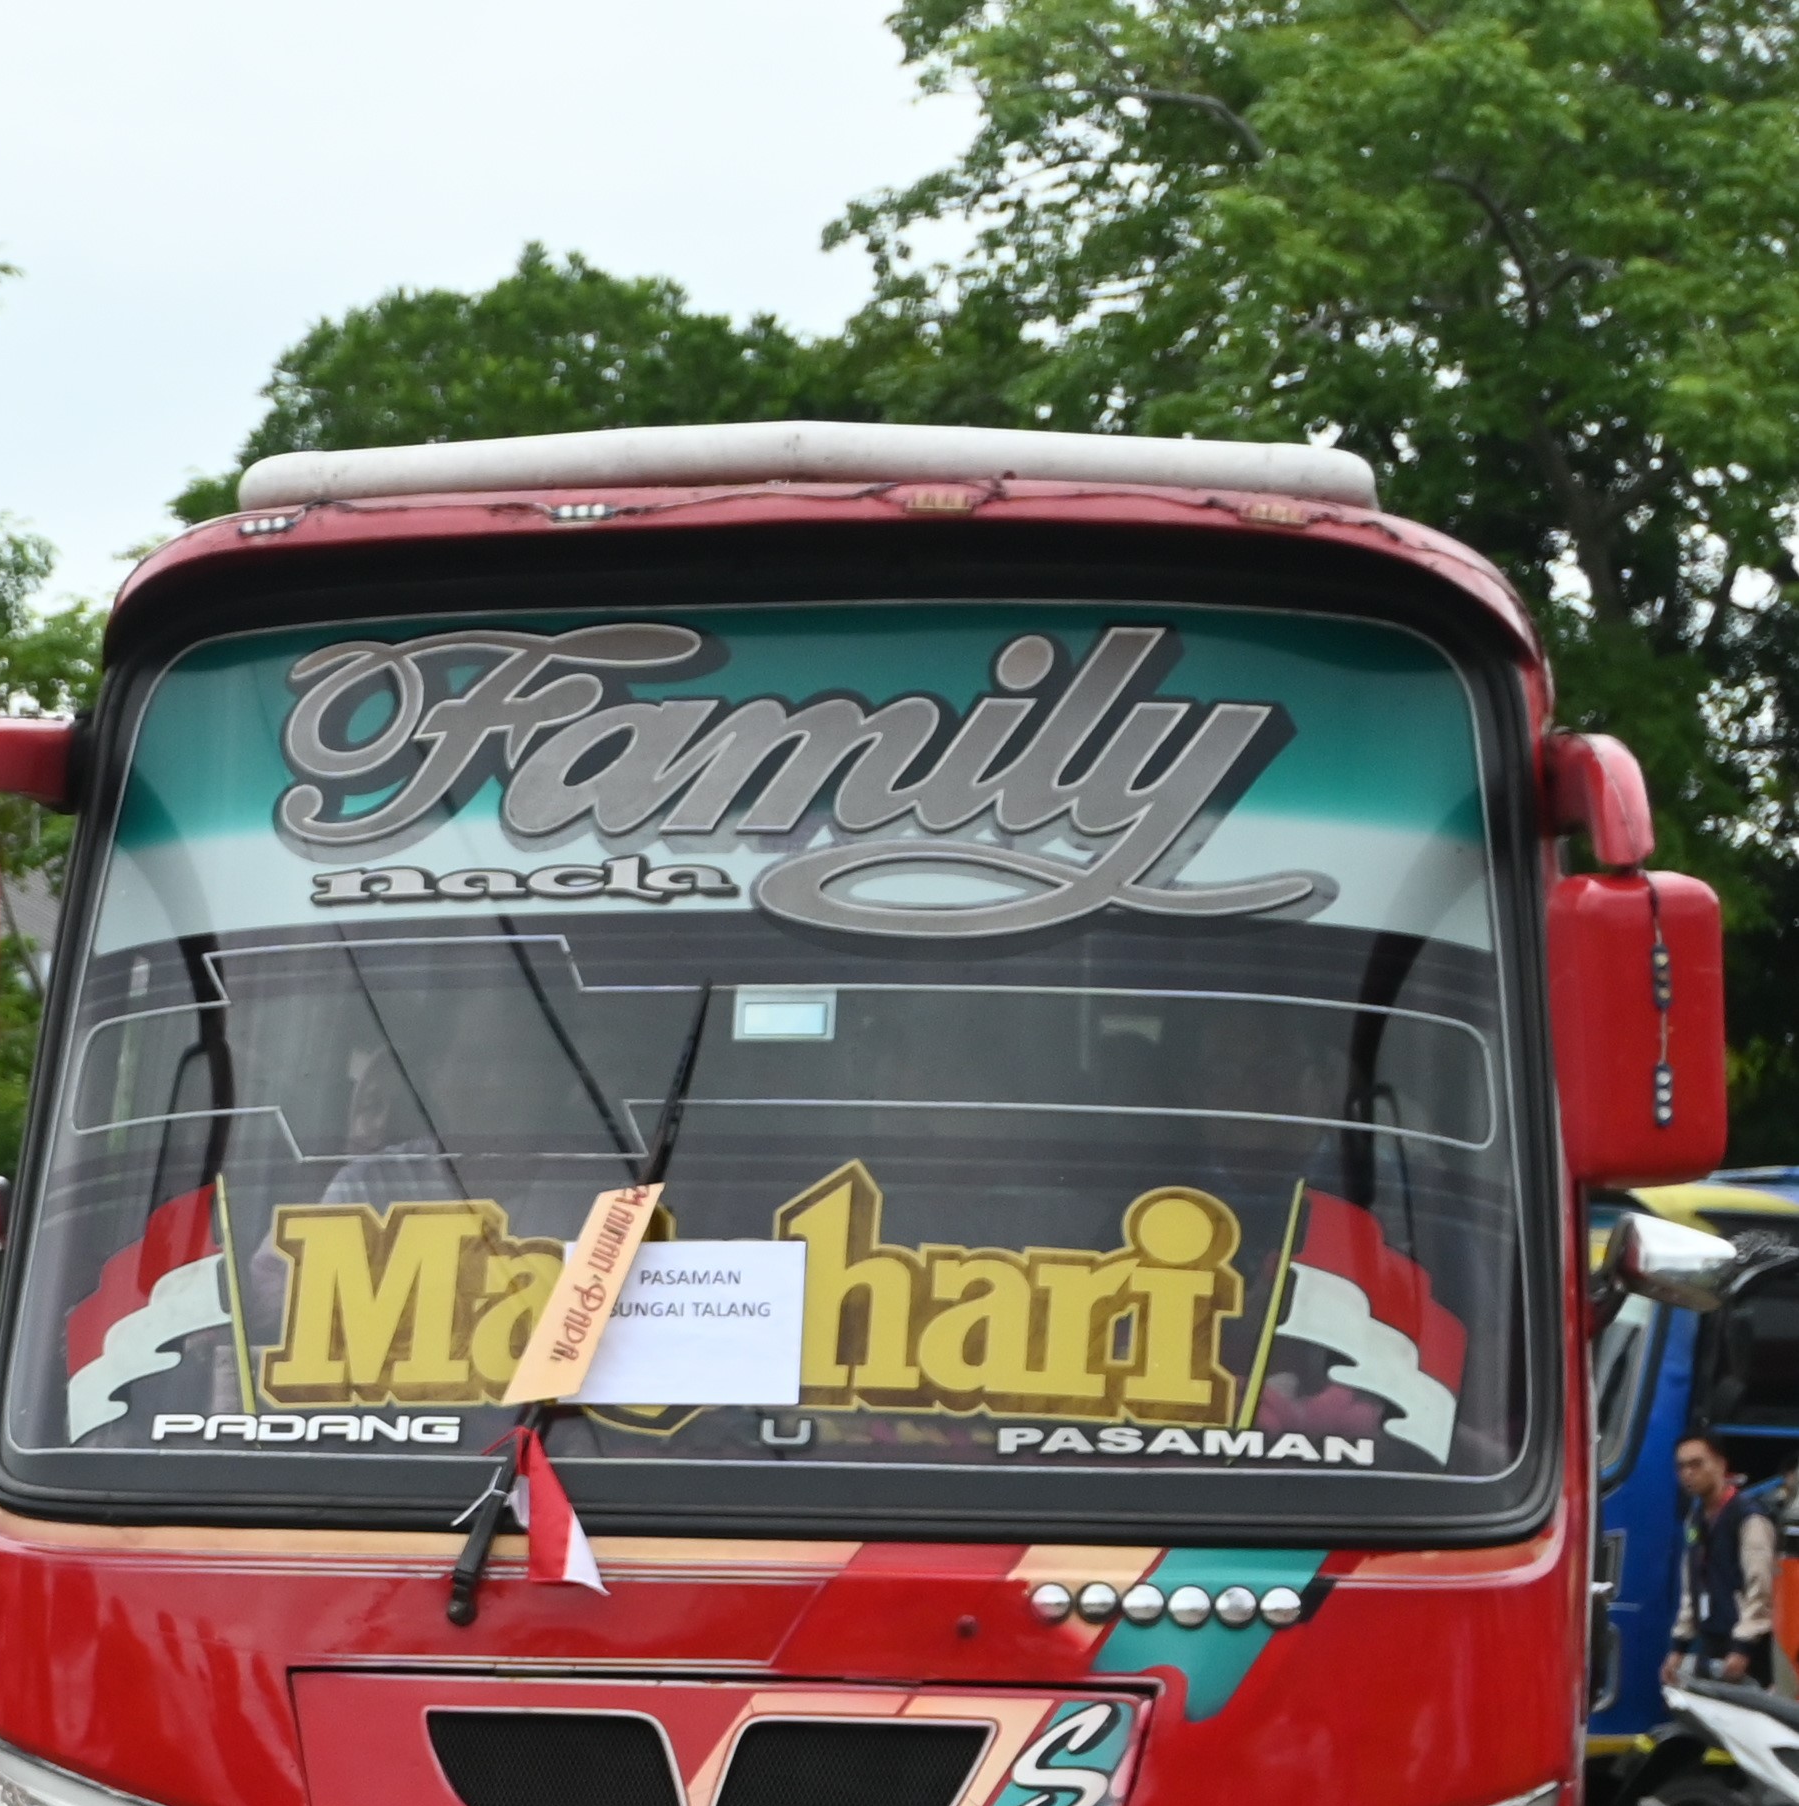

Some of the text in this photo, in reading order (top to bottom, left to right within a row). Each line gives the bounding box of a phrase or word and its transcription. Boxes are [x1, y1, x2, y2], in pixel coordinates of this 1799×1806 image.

[281, 622, 1316, 937] Family
[640, 1269, 742, 1286] PASAMAN
[692, 1302, 772, 1318] TALANG
[151, 1412, 461, 1446] PADANG
[997, 1424, 1376, 1468] PASAMAN
